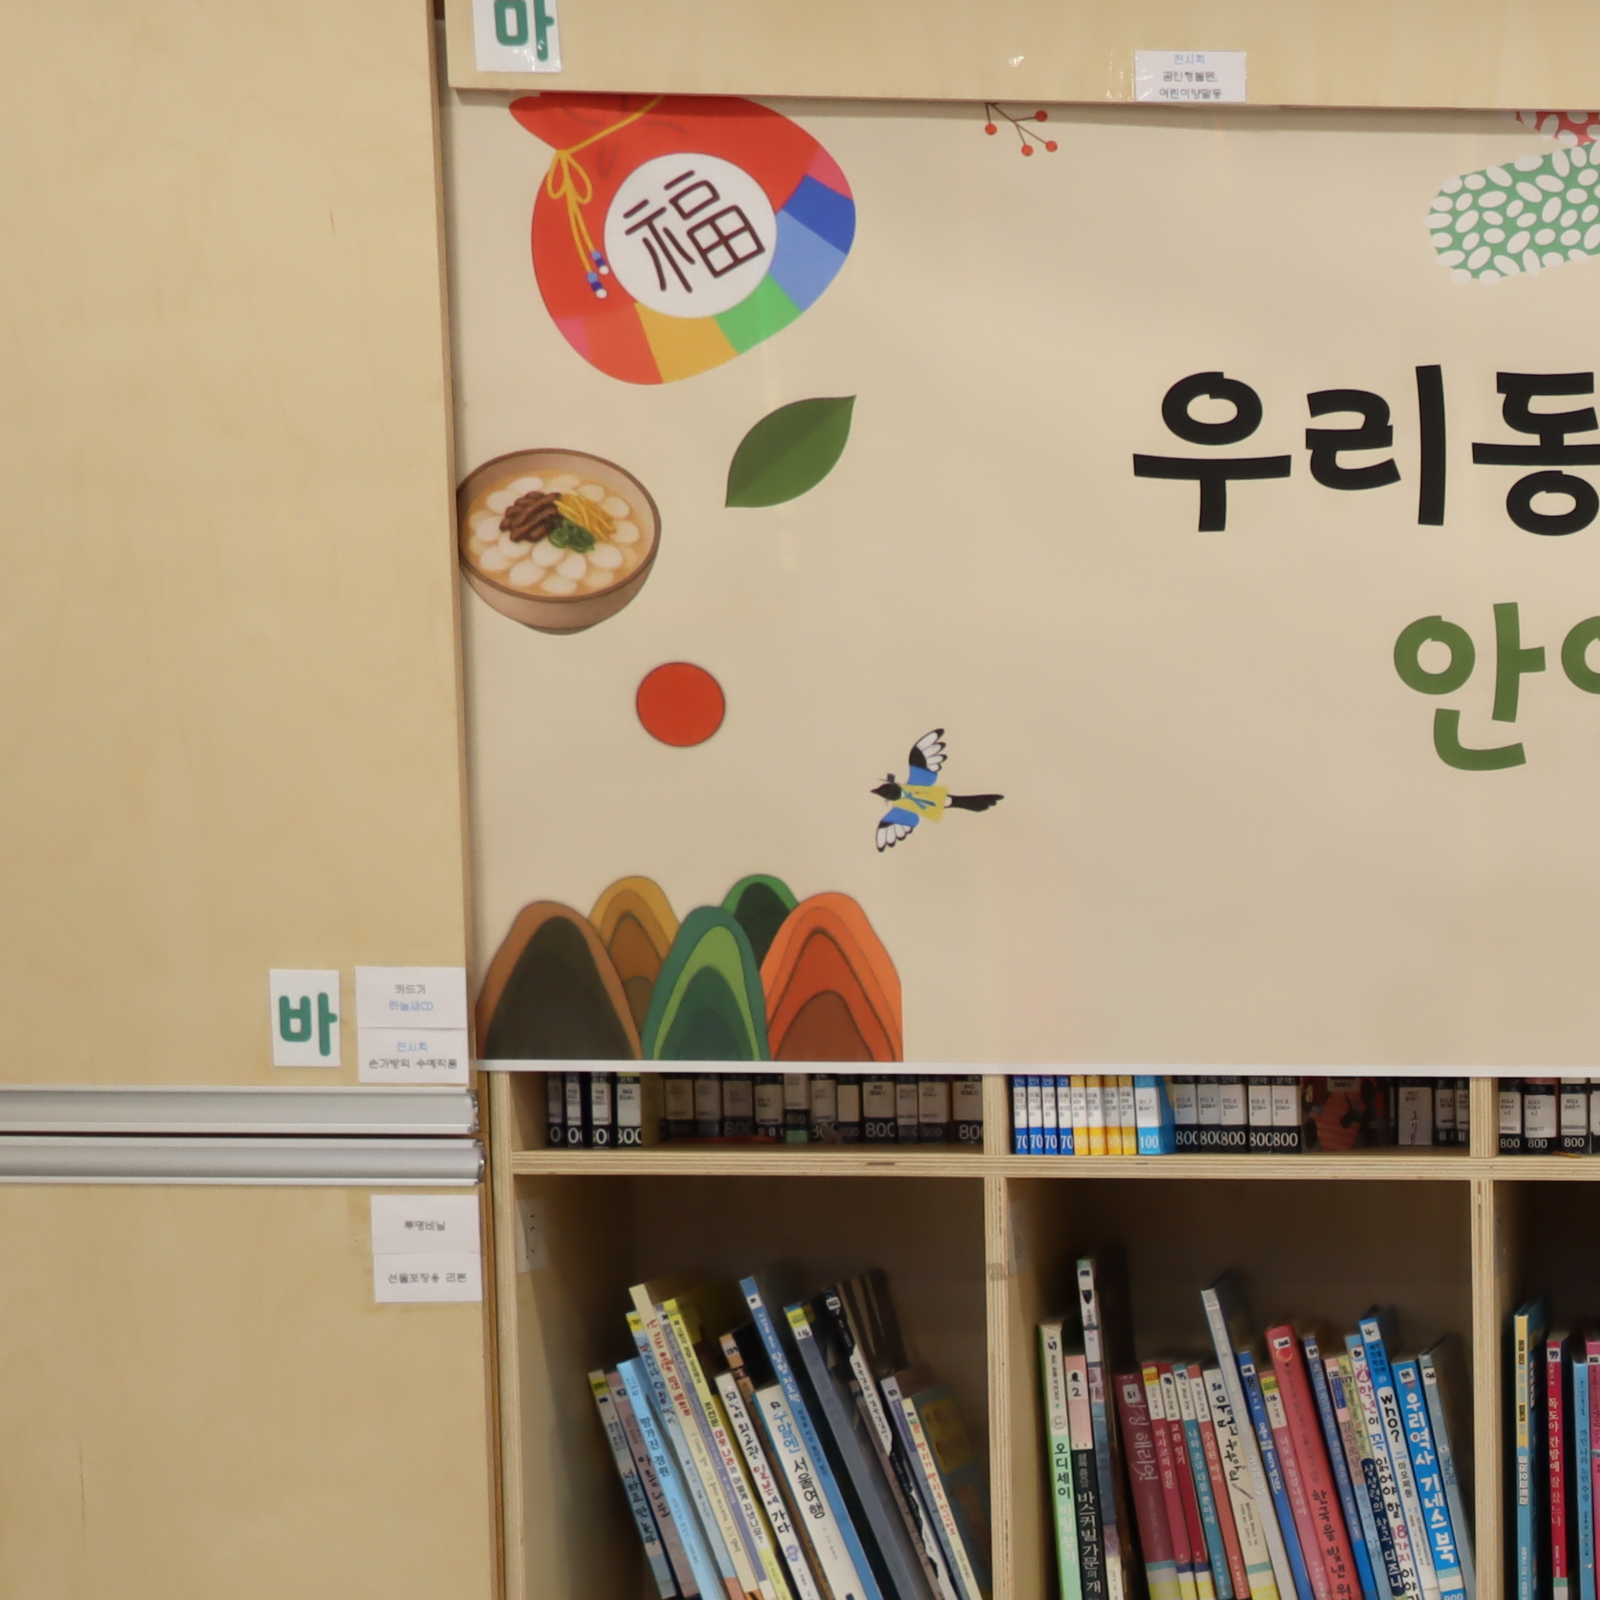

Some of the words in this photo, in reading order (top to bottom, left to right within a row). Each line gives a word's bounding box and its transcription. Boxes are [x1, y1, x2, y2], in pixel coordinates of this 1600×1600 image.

[494, 0, 554, 61] 마
[624, 170, 766, 294] 福
[279, 992, 338, 1056] 바
[1547, 1396, 1560, 1432] 독도야
[1053, 1442, 1072, 1500] 오디세이
[1549, 1436, 1561, 1472] 간밤에
[1312, 1489, 1335, 1541] 한국을
[1420, 1477, 1456, 1564] 기네스북
